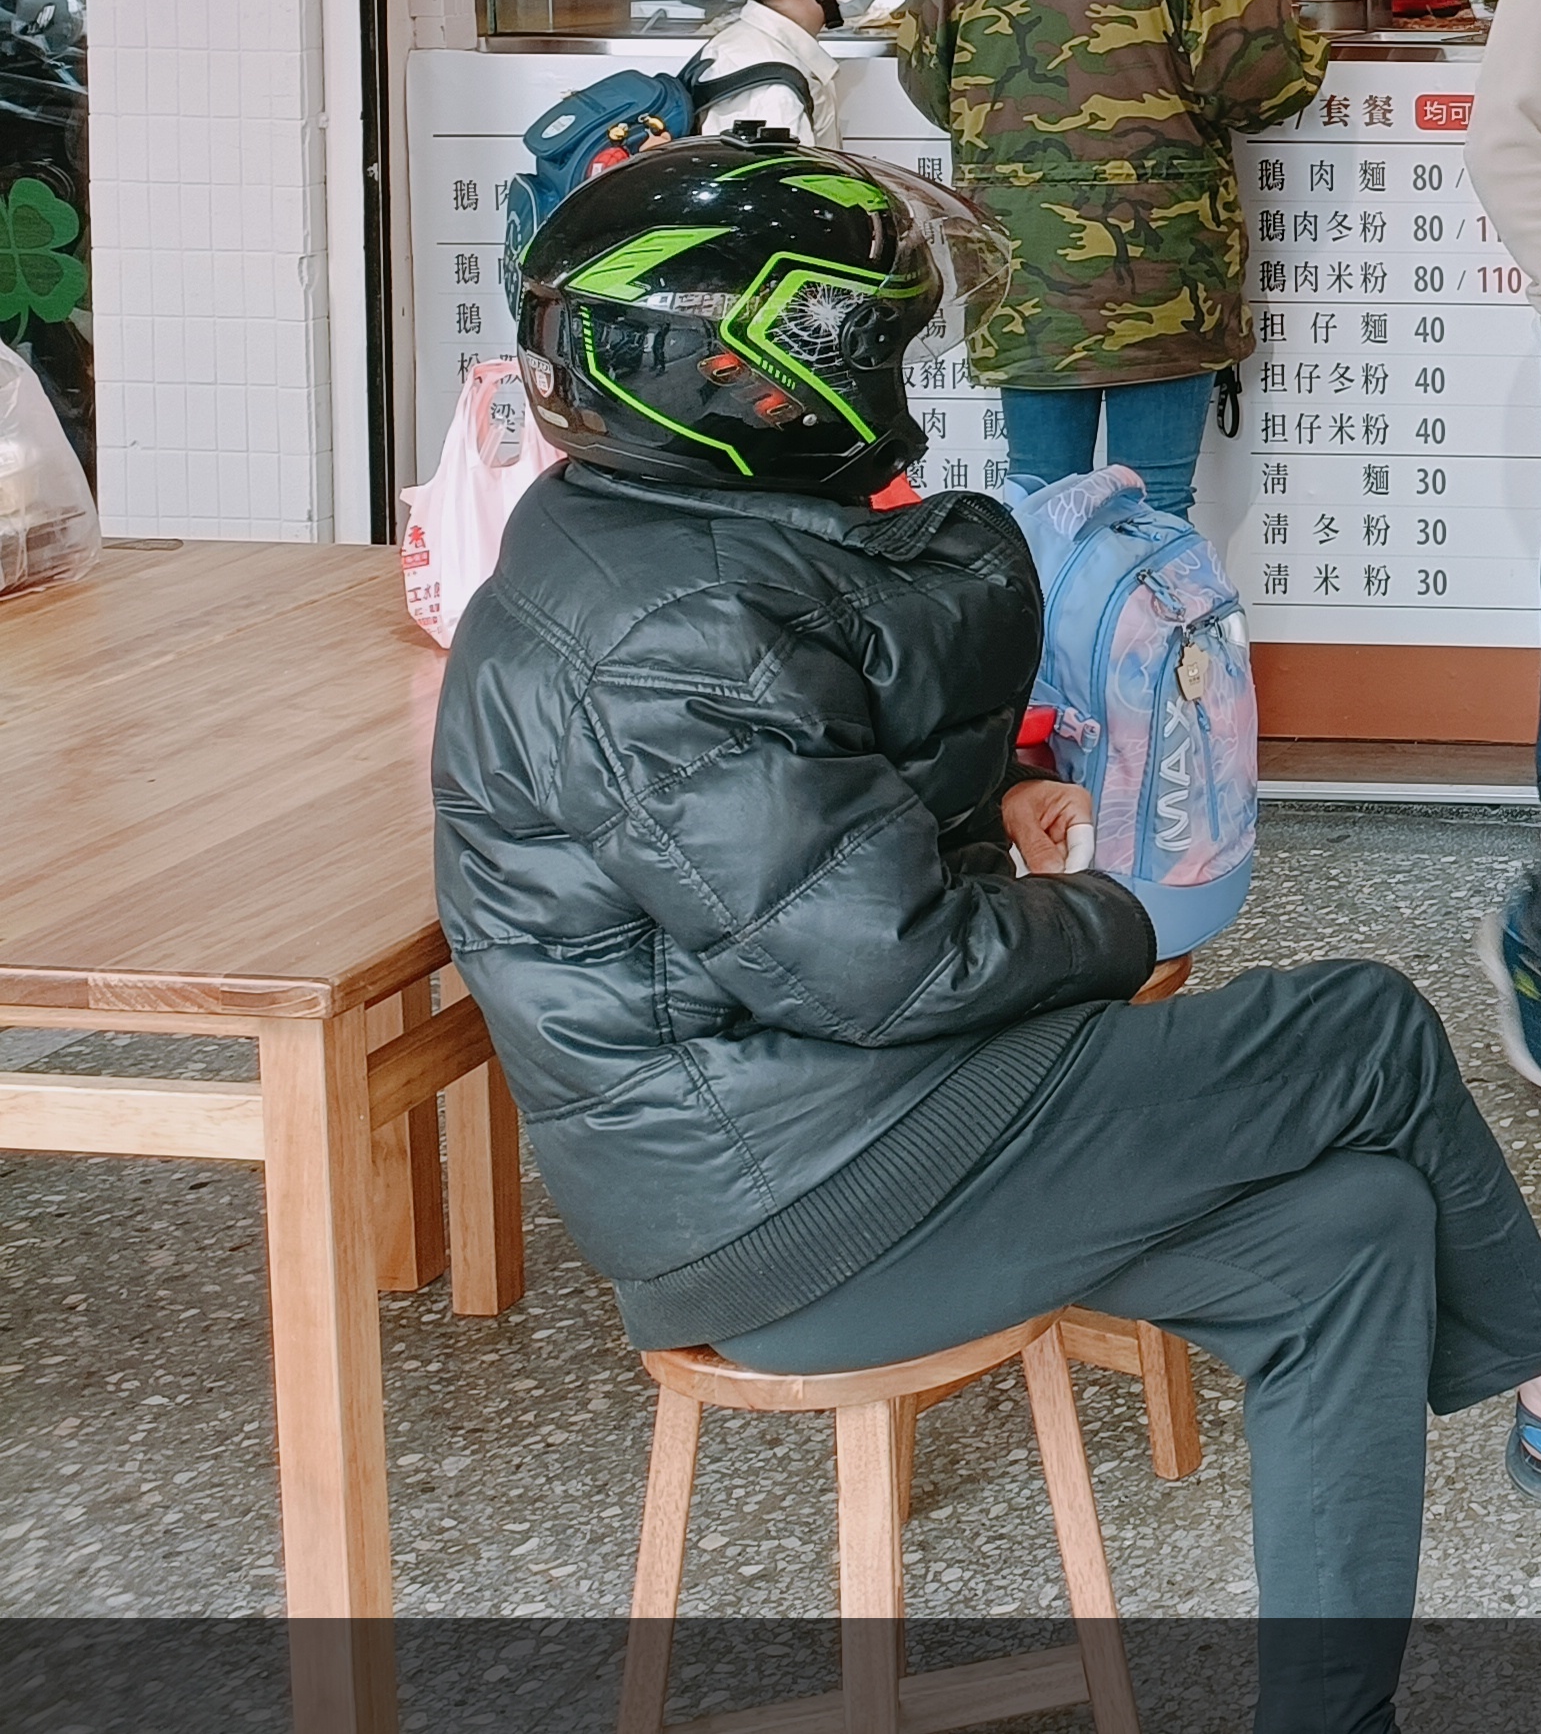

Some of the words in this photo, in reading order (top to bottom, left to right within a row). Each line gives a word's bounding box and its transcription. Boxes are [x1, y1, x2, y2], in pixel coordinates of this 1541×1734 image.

[1262, 95, 1394, 130] /套餐
[1258, 159, 1387, 192] 鵝肉麵
[1412, 164, 1443, 191] 80
[1258, 211, 1388, 244] 鵝肉冬粉
[1413, 216, 1443, 242] 80
[1259, 261, 1388, 294] 鵝肉米粉
[1413, 267, 1444, 293] 80
[1477, 267, 1522, 293] 110
[1259, 311, 1389, 344] 担仔麵
[1414, 317, 1445, 343] 40
[1260, 362, 1389, 395] 担仔冬粉
[1414, 367, 1445, 394] 40
[1261, 412, 1390, 445] 担仔米粉
[1415, 418, 1446, 444] 40
[1416, 468, 1447, 495] 30
[1262, 513, 1391, 546] 清冬粉
[1416, 519, 1447, 546] 30
[1263, 563, 1391, 596] 清米粉
[1417, 569, 1448, 596] 30
